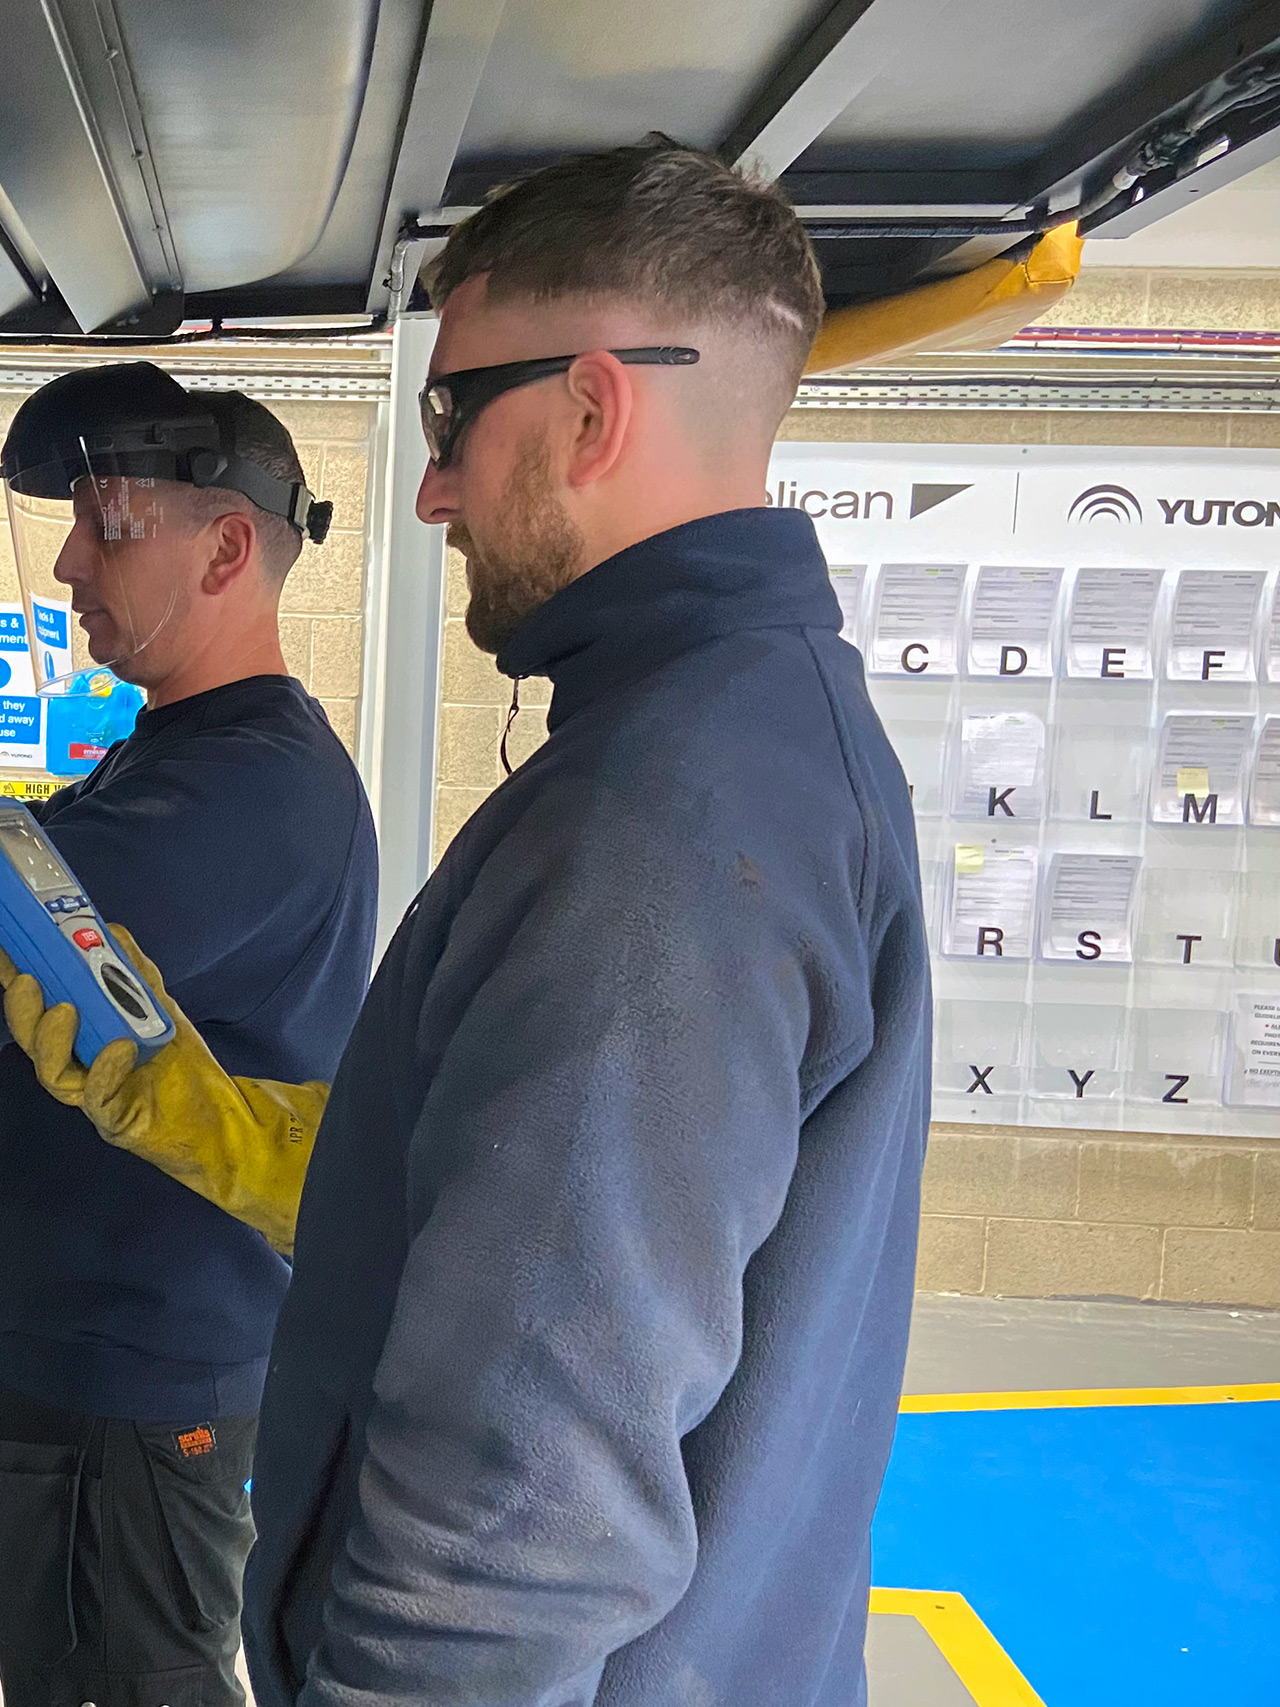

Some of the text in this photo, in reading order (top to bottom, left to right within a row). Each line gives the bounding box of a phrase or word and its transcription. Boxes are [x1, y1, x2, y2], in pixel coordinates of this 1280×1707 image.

[10, 617, 19, 628] &
[901, 643, 1225, 680] C D E F
[3, 700, 25, 712] they
[7, 715, 34, 726] away
[25, 784, 50, 795] HIGH
[987, 787, 1219, 824] K L M
[977, 927, 1202, 964] R S T
[966, 1065, 1189, 1104] X Y Z
